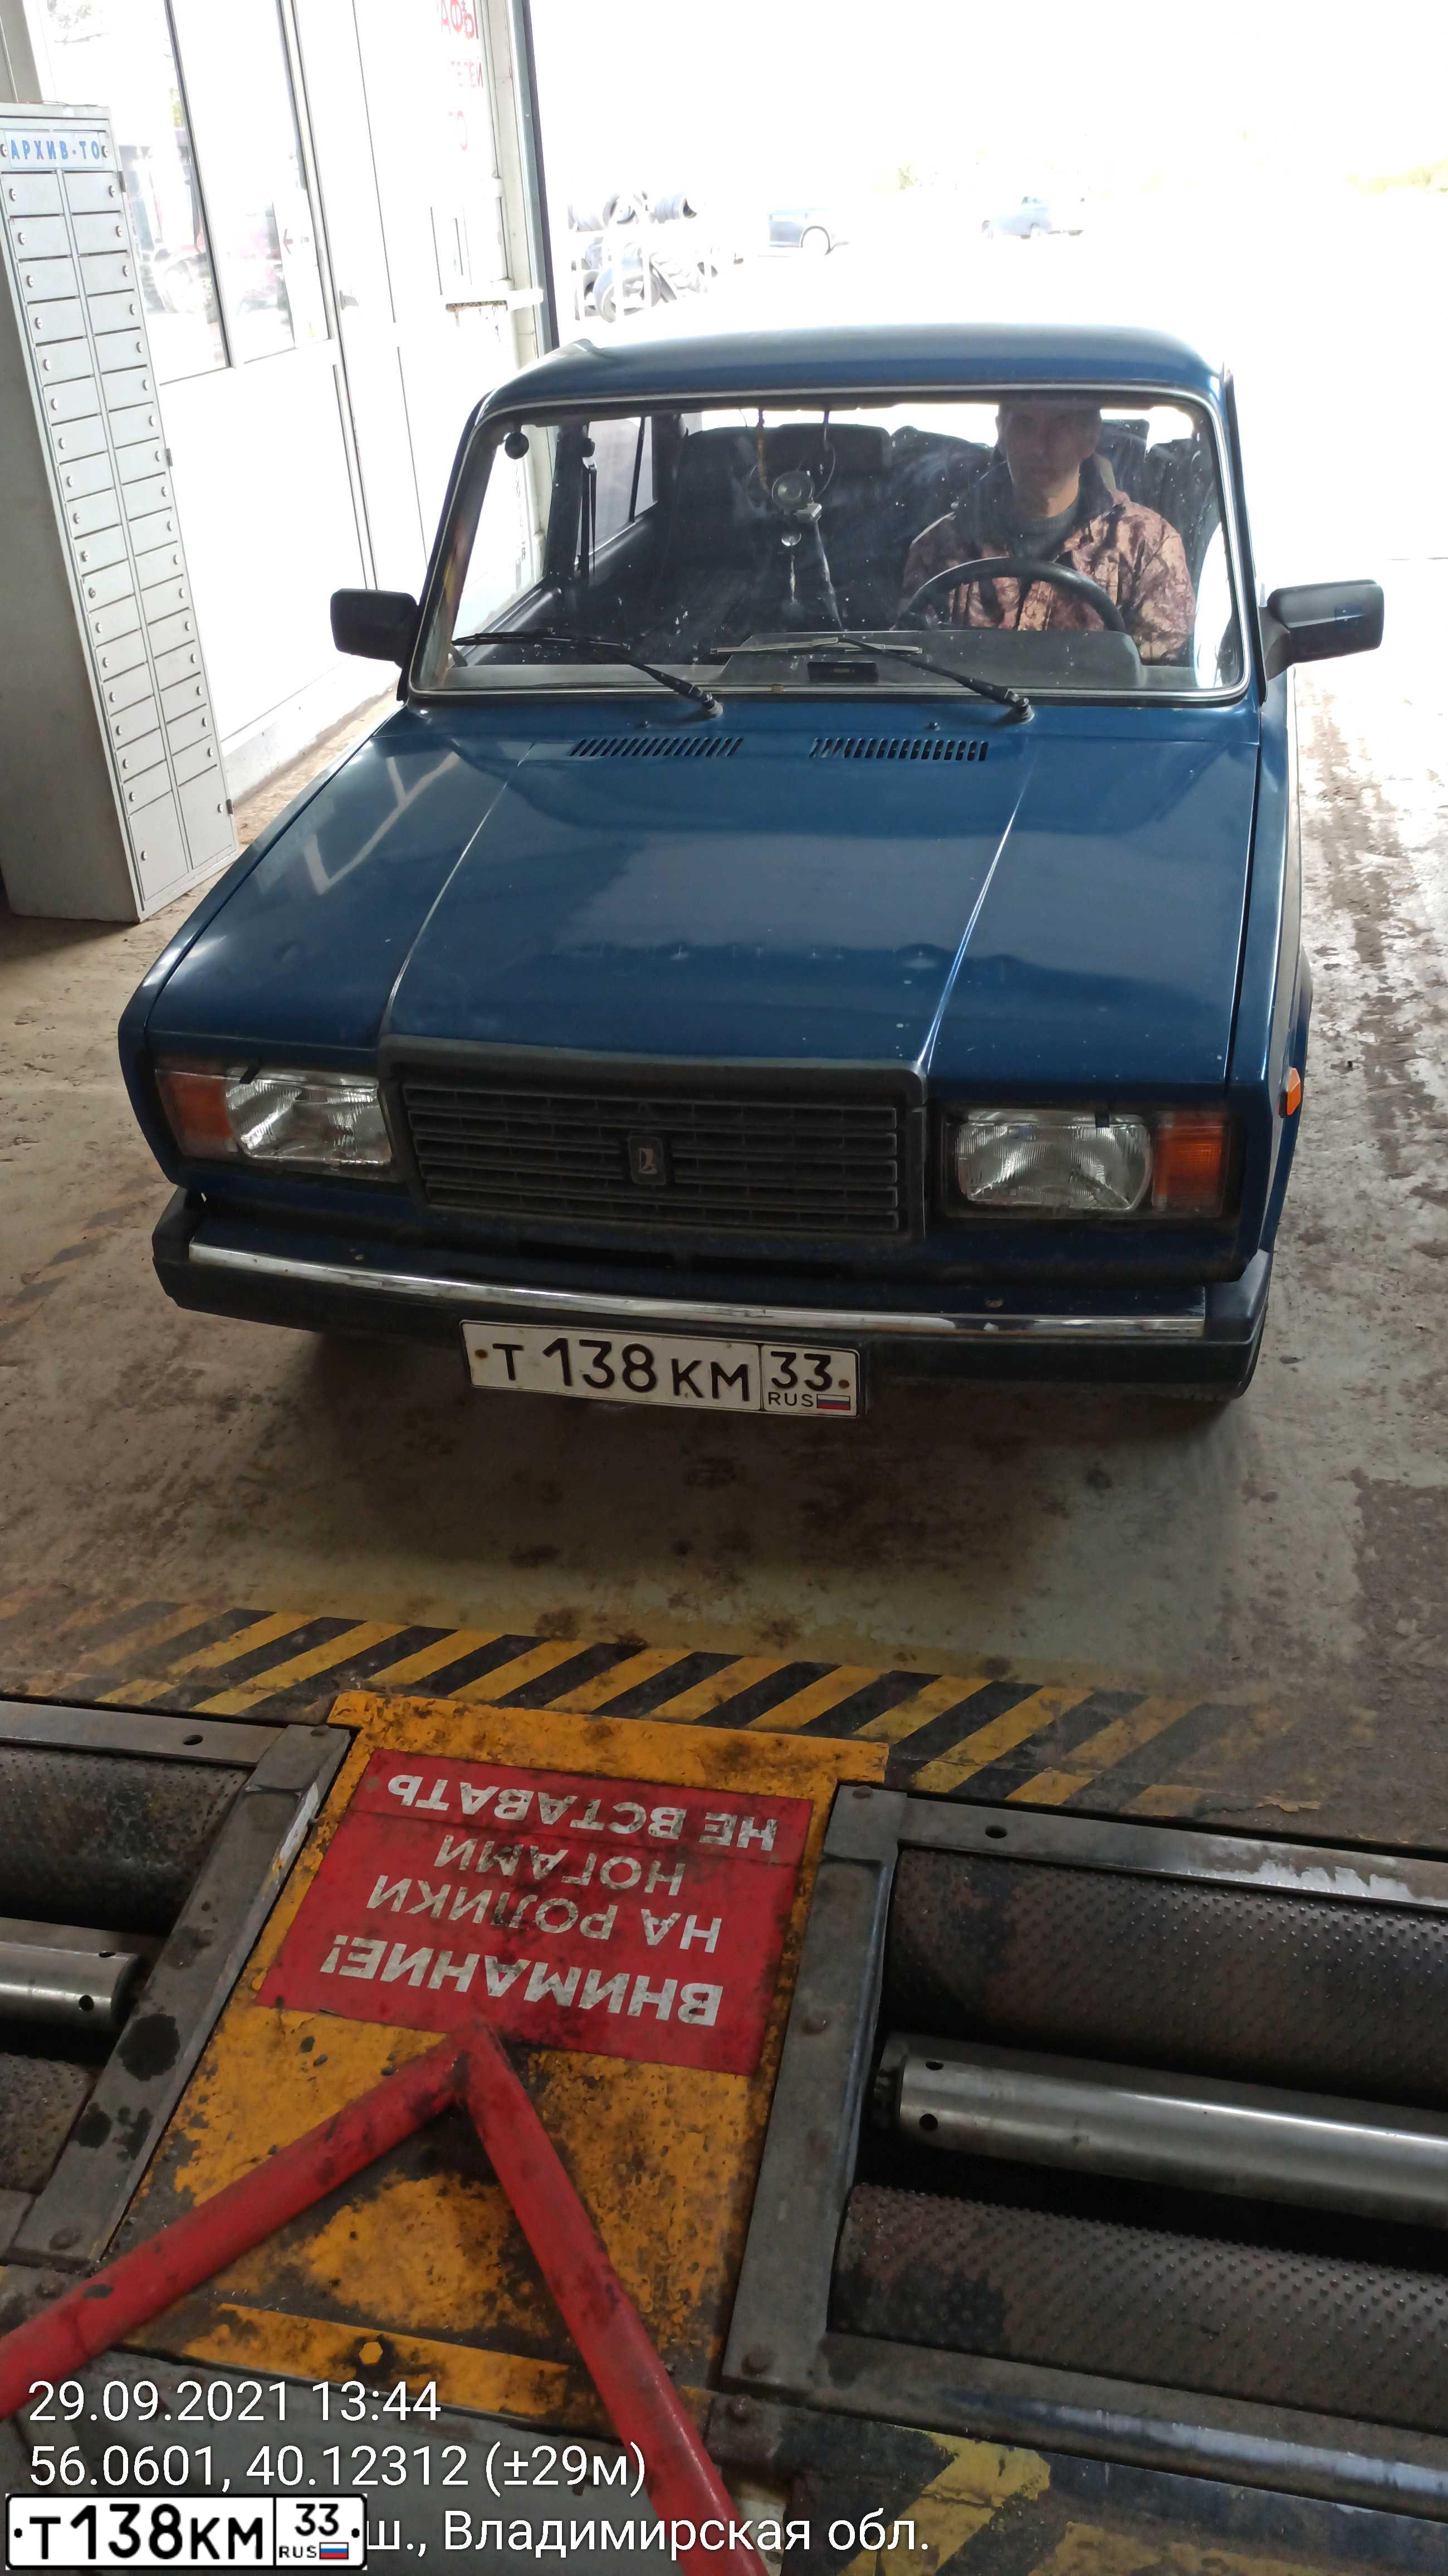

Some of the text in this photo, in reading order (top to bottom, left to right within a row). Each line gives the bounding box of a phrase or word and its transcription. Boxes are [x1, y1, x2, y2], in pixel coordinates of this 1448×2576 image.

[768, 1392, 814, 1408] RUS
[770, 1351, 833, 1392] 33
[388, 1774, 777, 1851] НЕ ВСТАВАТЬ
[433, 1835, 684, 1896] НОГАМИ
[365, 1875, 722, 1953] НА РОЛИКИ
[320, 1935, 723, 2026] ВНИМАНИЕ!
